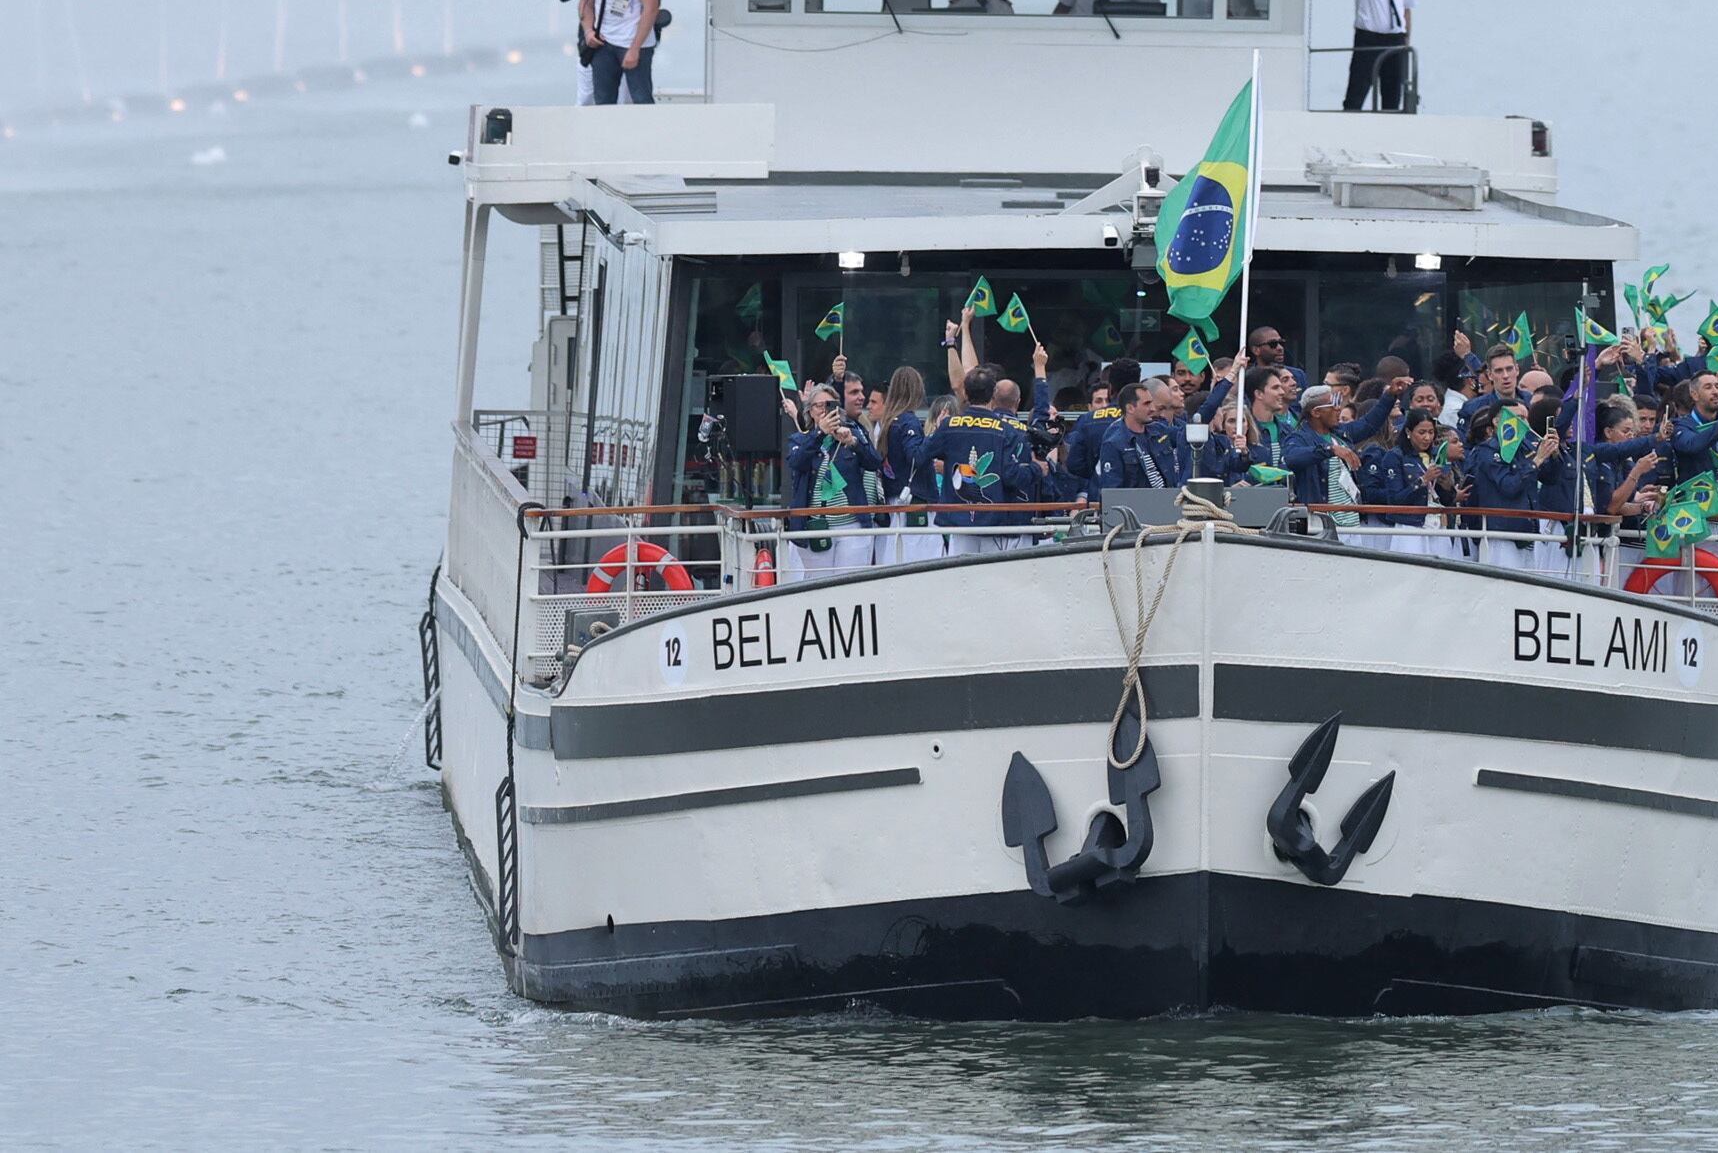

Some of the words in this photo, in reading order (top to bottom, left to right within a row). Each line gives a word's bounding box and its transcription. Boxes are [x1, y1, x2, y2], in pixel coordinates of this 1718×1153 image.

[948, 415, 1004, 431] BRASIL
[1093, 407, 1122, 419] BRA
[664, 636, 682, 667] 12
[712, 612, 787, 671] BEL
[796, 603, 879, 663] AMI
[1514, 609, 1595, 667] BEL
[1603, 616, 1668, 673] AMI
[1682, 637, 1698, 668] 12
